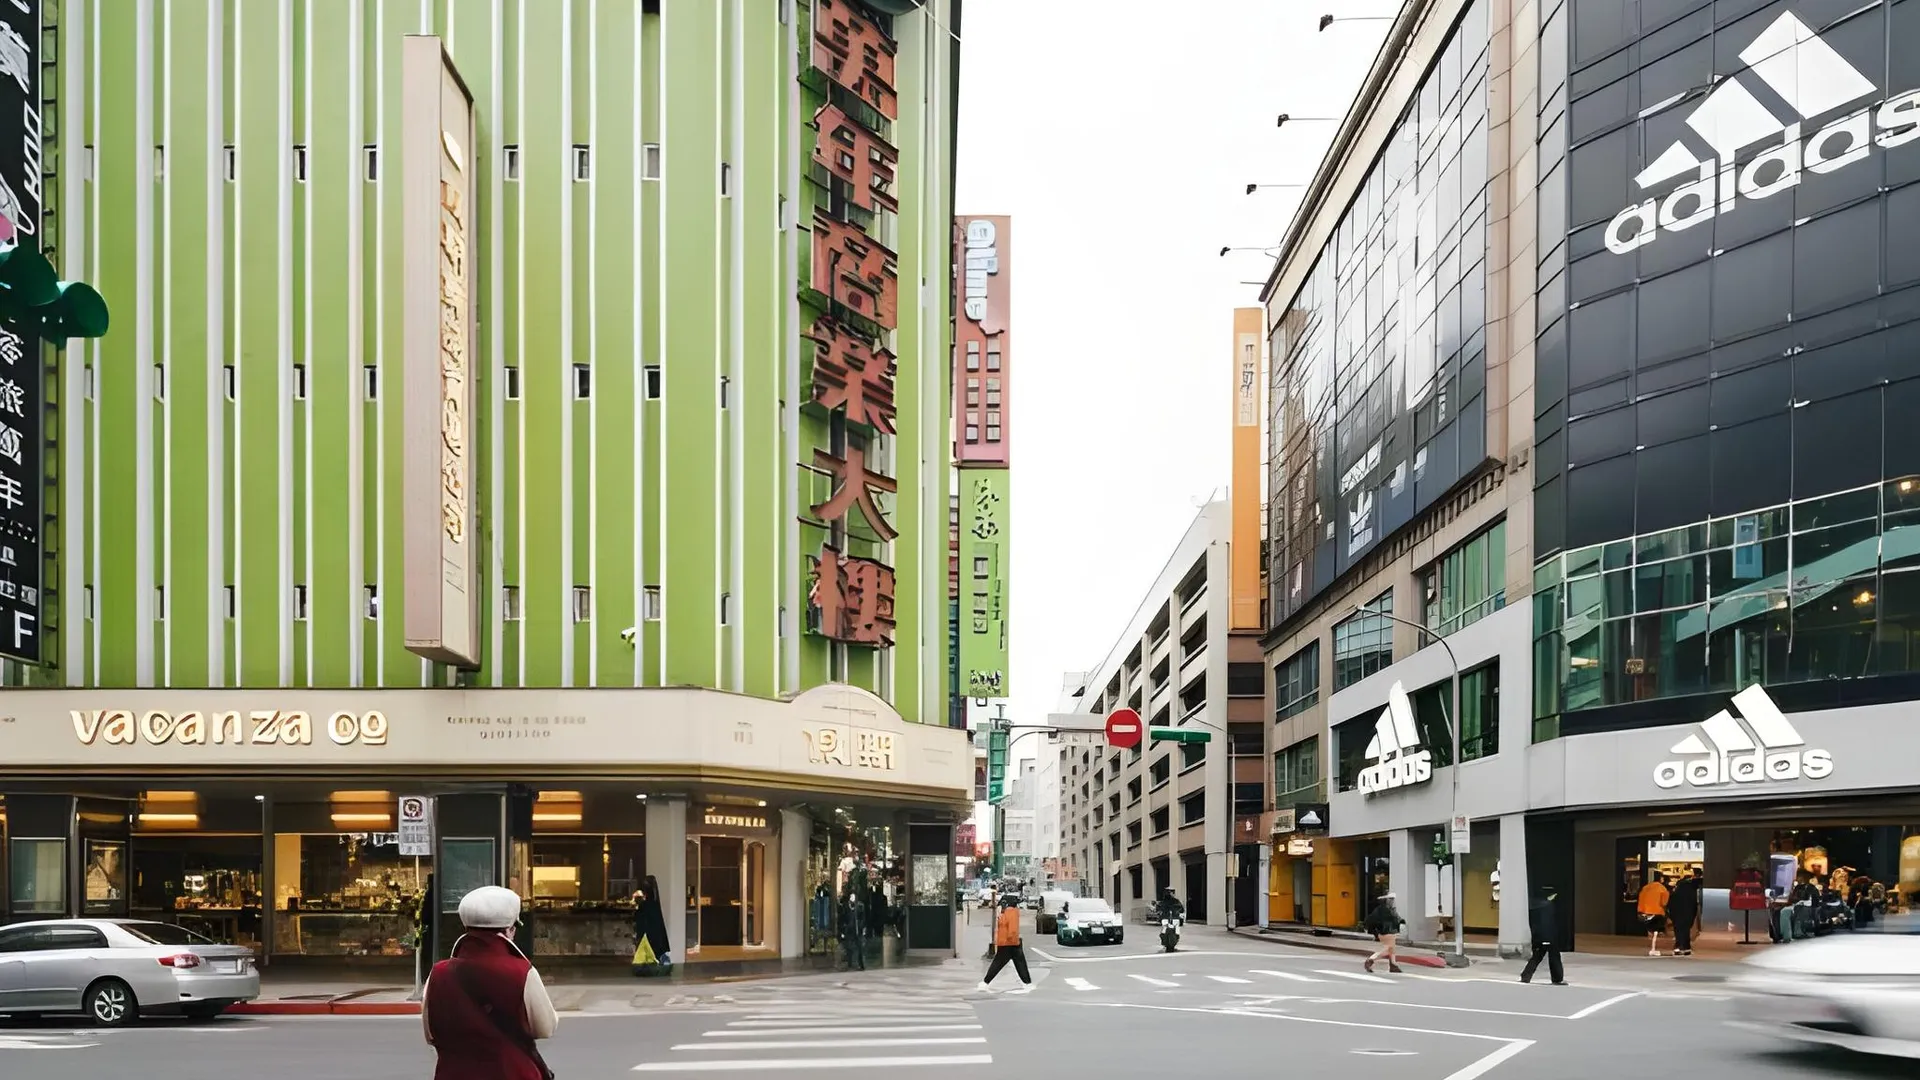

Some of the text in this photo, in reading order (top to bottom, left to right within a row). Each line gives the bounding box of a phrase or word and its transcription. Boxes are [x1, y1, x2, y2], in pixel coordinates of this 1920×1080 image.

[1604, 88, 1920, 255] adidas
[1357, 748, 1432, 795] adidas
[1653, 747, 1834, 789] adidas
